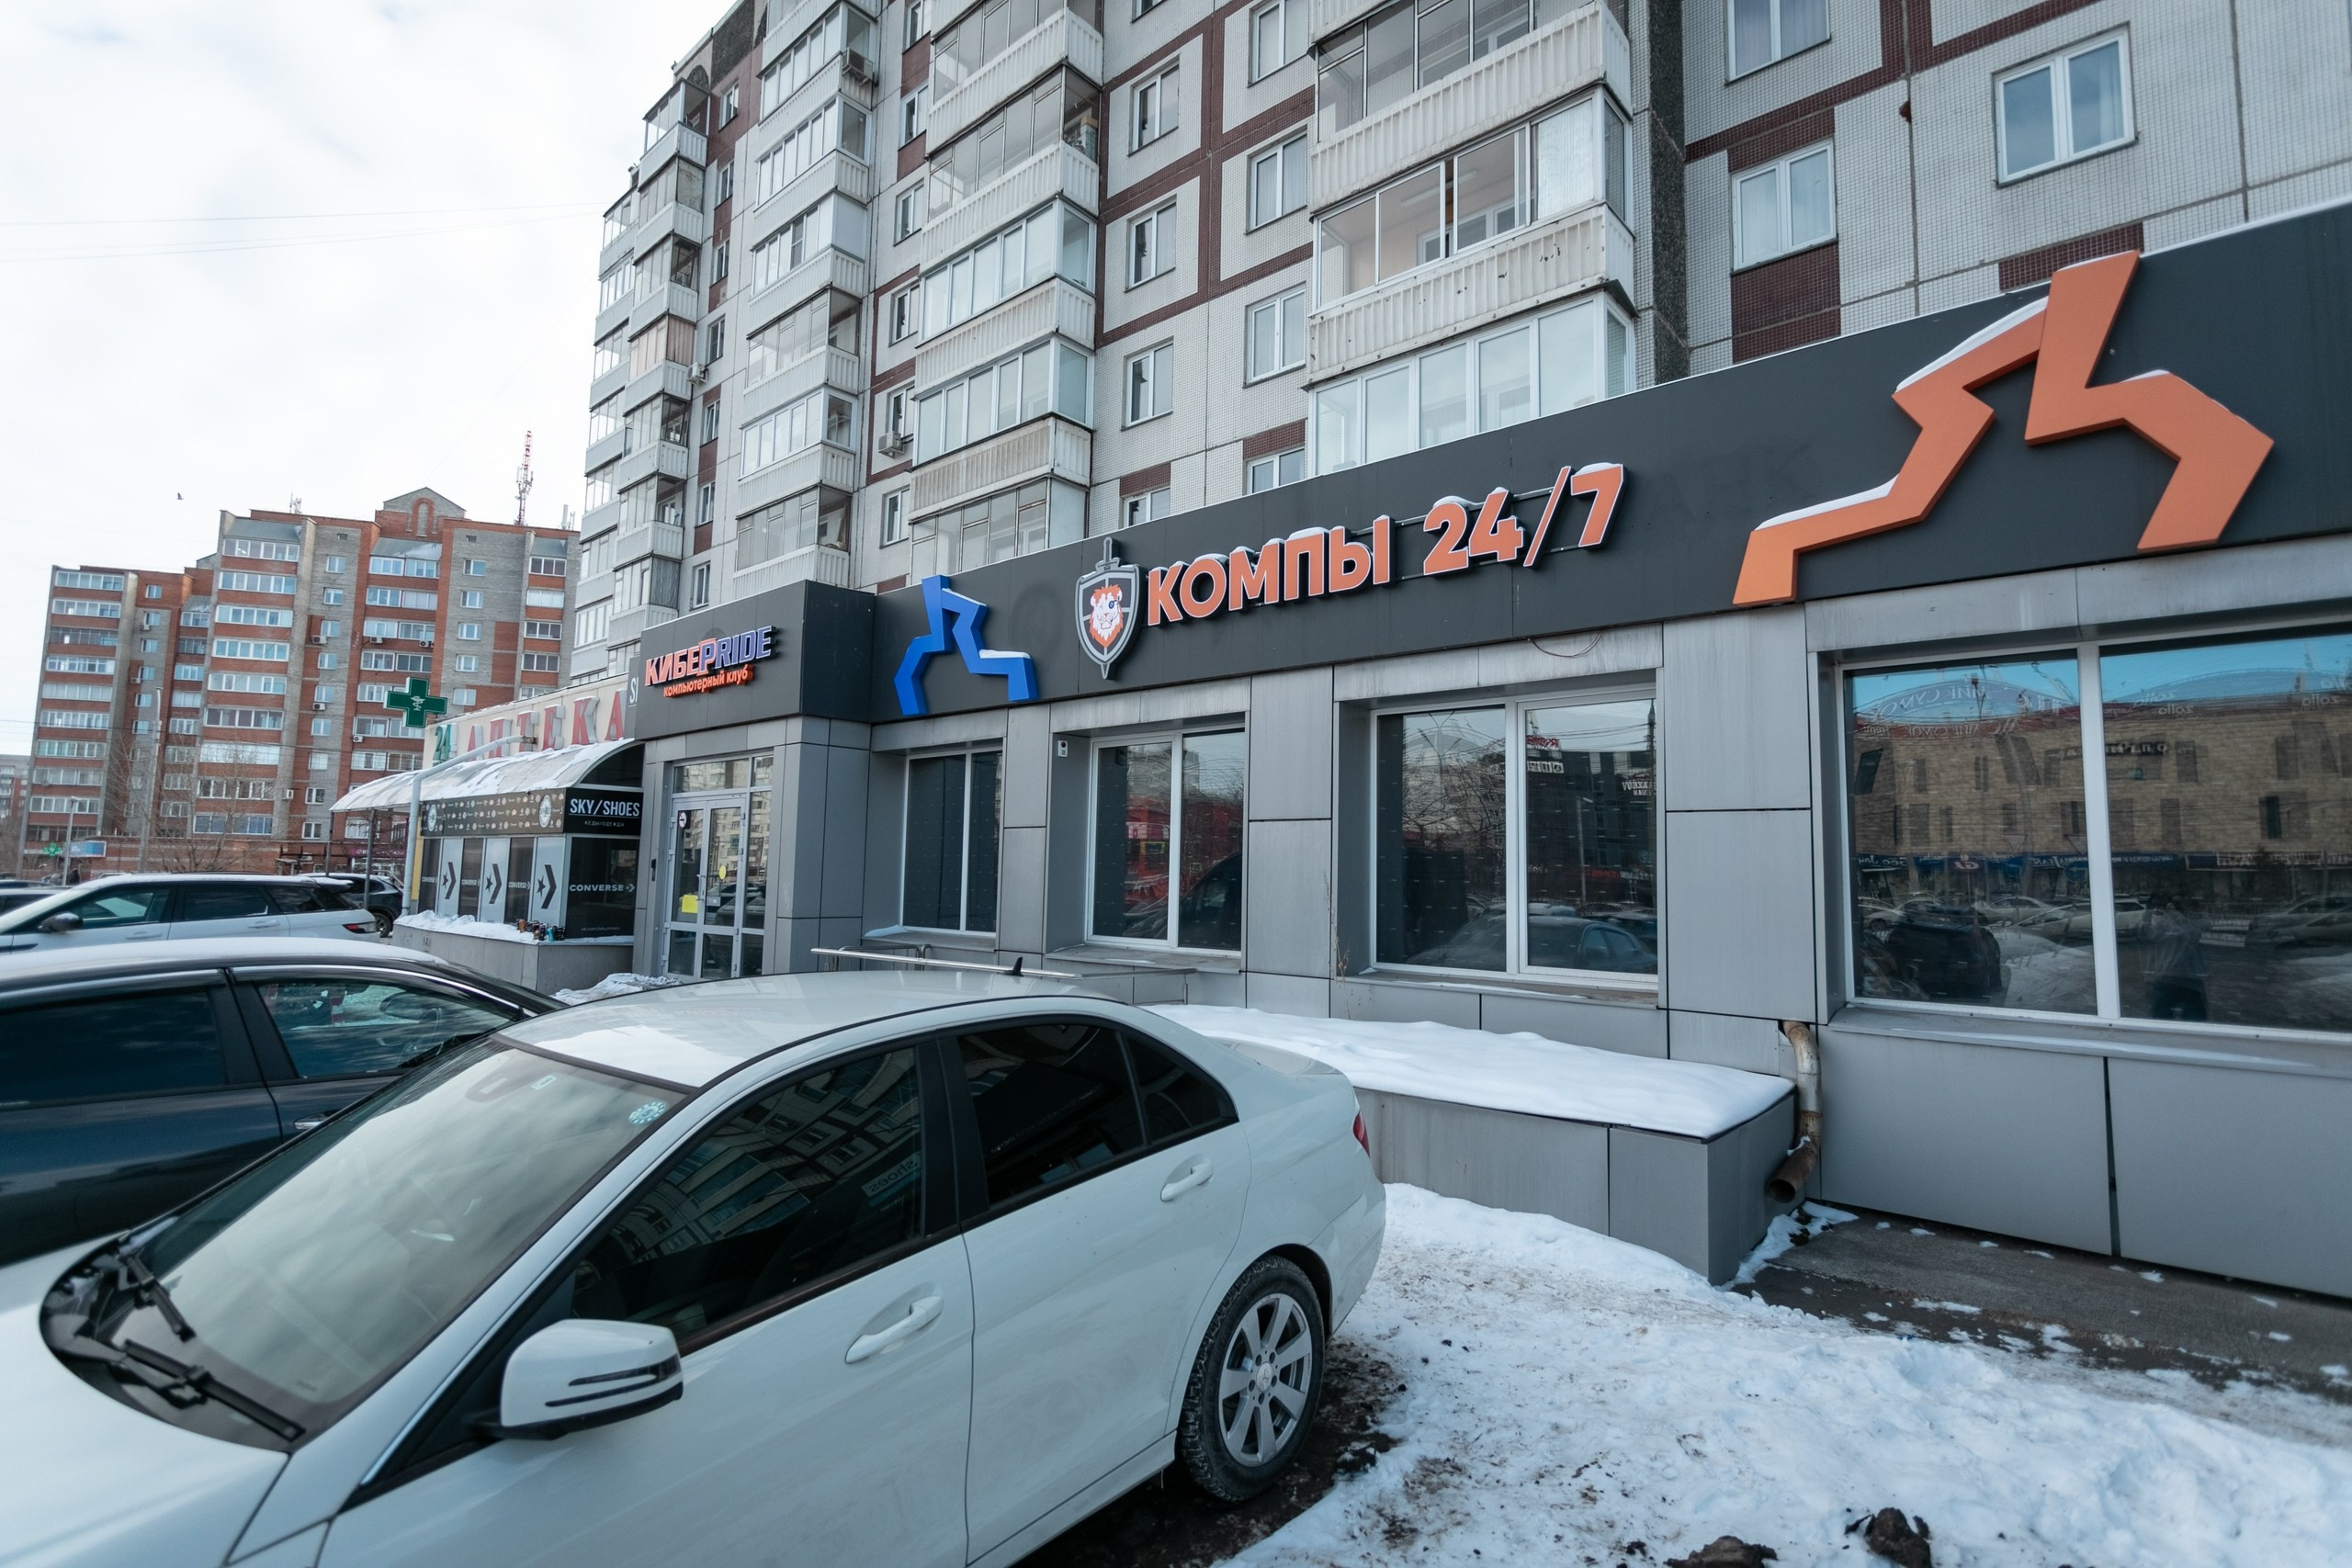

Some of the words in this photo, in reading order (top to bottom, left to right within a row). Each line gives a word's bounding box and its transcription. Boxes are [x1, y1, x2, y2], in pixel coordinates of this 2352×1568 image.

[1148, 515, 1391, 626] КОМПЫ
[1423, 463, 1625, 575] 24/7
[663, 670, 725, 698] компьютерный
[726, 664, 749, 684] клуб
[468, 690, 626, 761] АПТЕКА
[570, 798, 640, 817] SKY/SHOES
[508, 881, 526, 889] CONVERSE
[569, 884, 625, 892] CONVERSE
